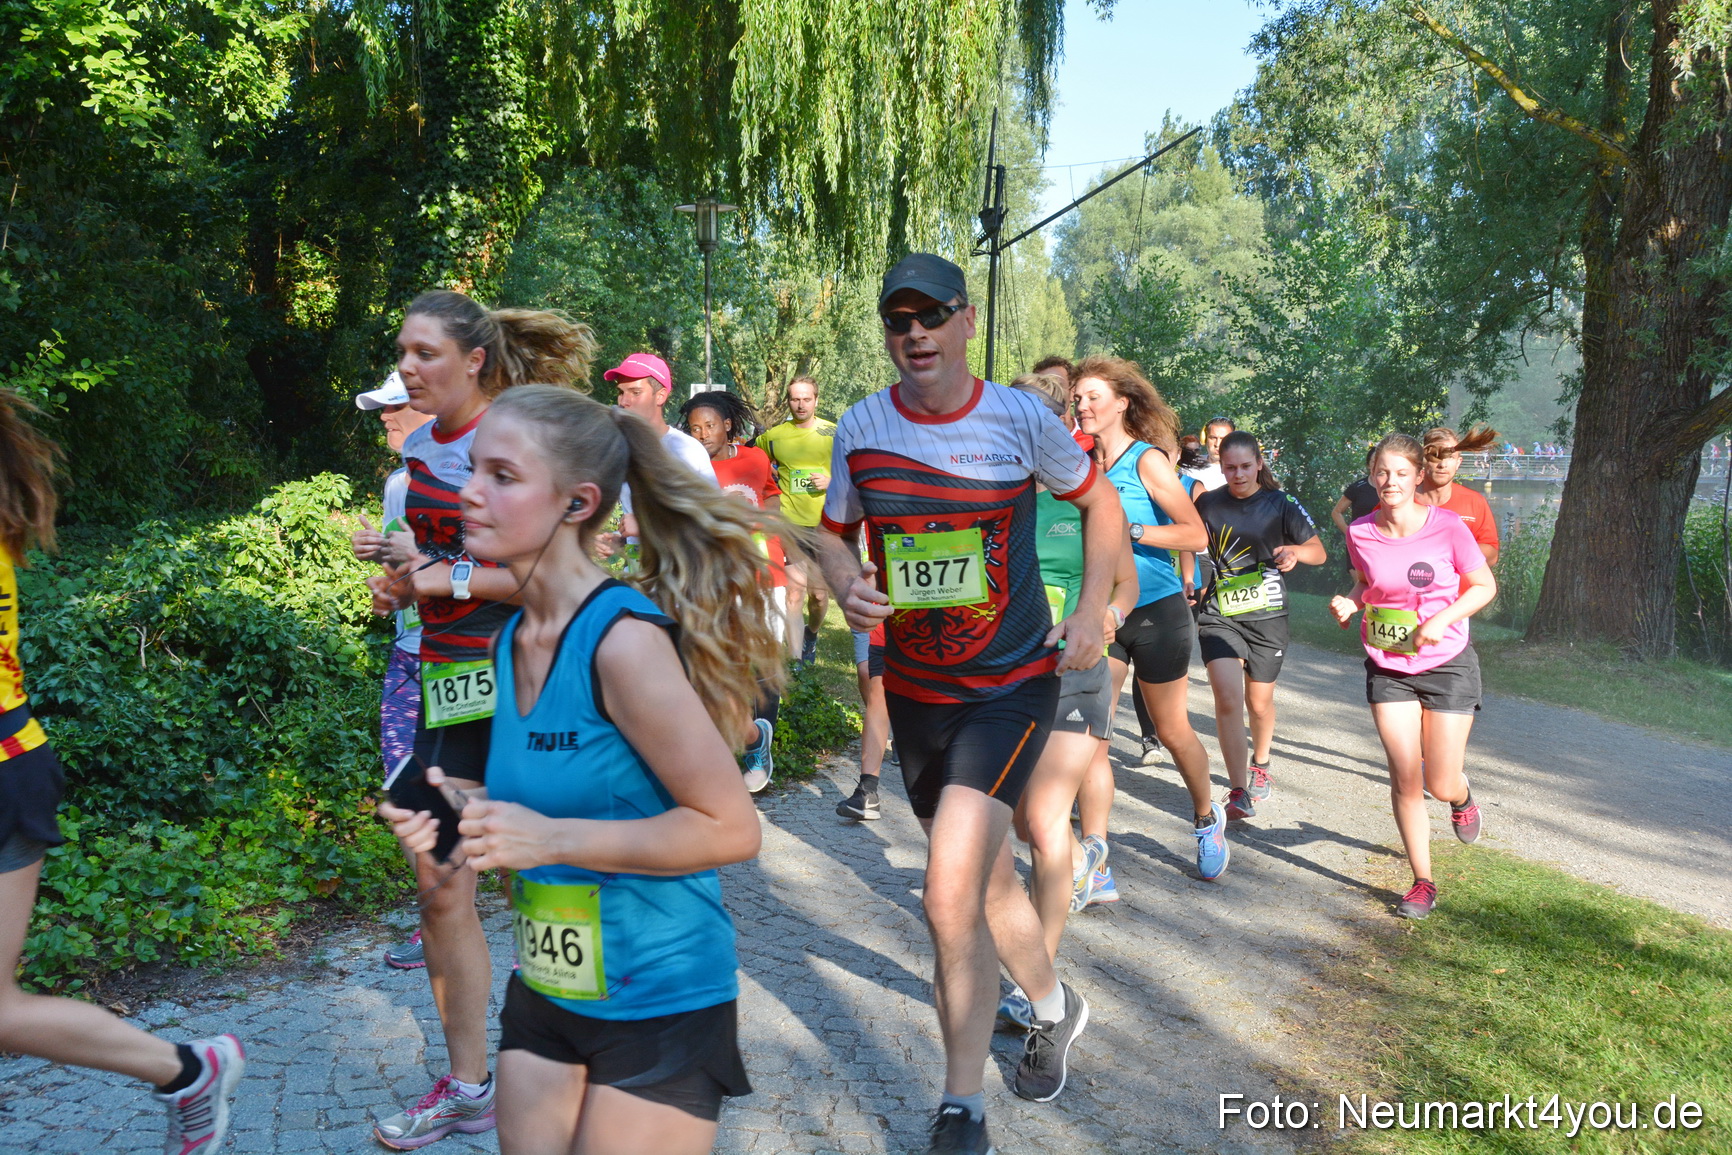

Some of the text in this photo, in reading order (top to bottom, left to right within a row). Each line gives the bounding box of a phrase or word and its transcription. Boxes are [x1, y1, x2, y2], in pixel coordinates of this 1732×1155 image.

[950, 453, 1012, 465] NEUMARKT
[794, 478, 813, 488] 162
[1046, 522, 1077, 535] AOK
[899, 557, 970, 588] 1877
[910, 588, 936, 597] Jürgen
[1223, 586, 1259, 605] 1426
[1371, 620, 1409, 642] 1443
[432, 670, 493, 706] 1875
[527, 731, 579, 752] THULE
[517, 913, 583, 967] 1946
